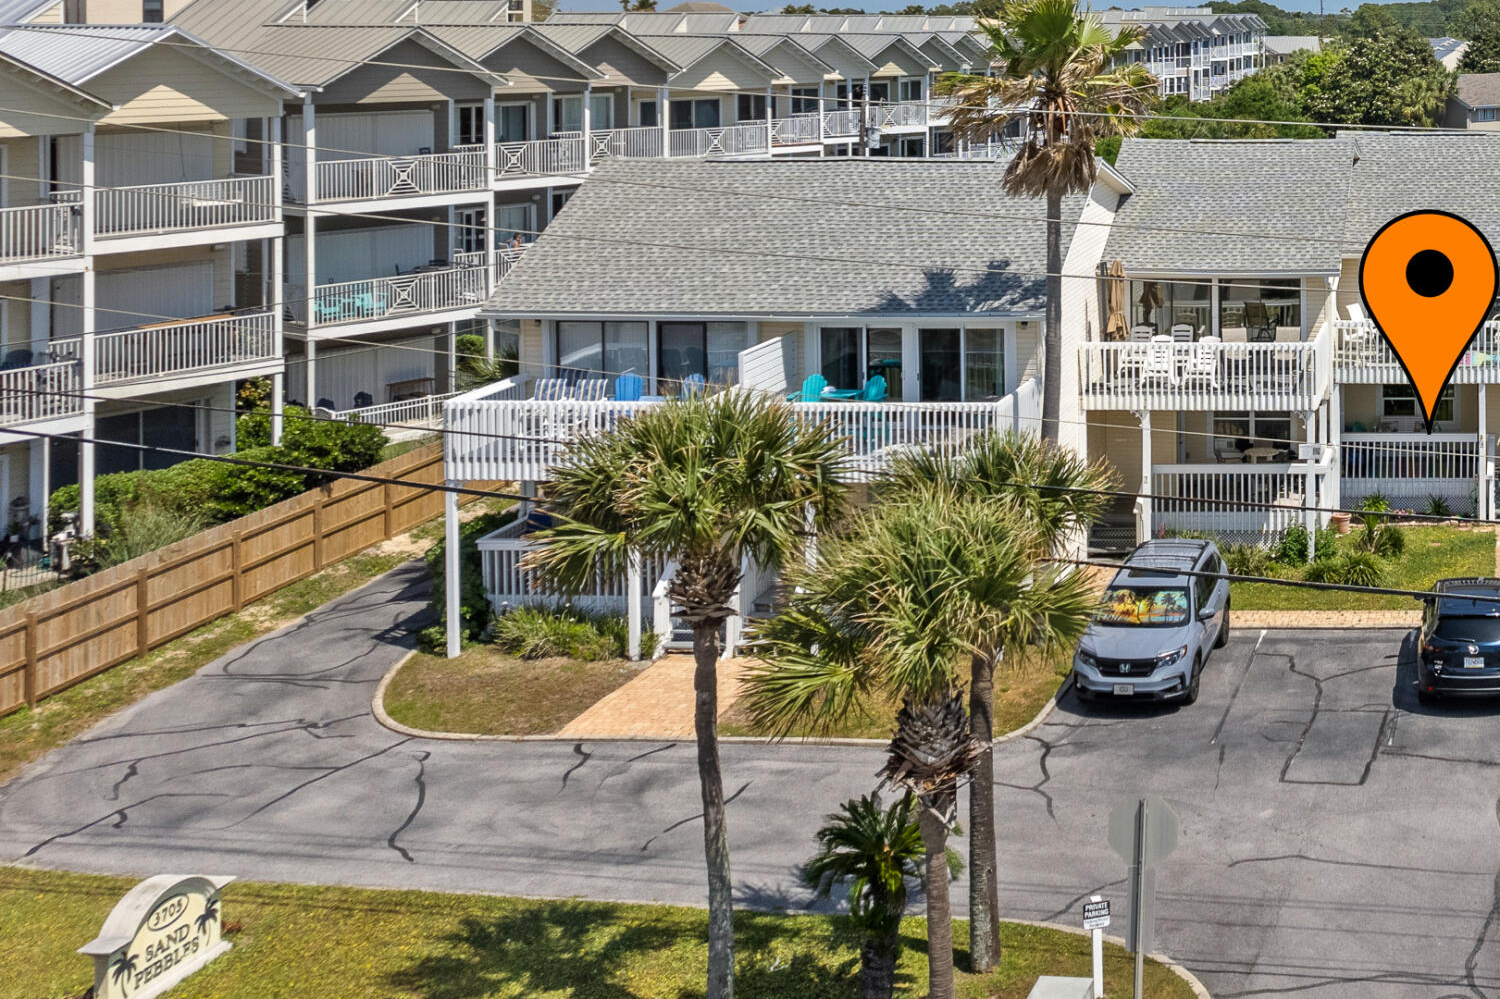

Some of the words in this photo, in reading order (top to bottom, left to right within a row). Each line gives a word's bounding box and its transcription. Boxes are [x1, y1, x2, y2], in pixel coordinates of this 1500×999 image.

[153, 898, 183, 927] 3705
[1084, 909, 1109, 919] PARKING
[1085, 901, 1109, 912] PRIVATE
[145, 923, 190, 962] SAND
[134, 936, 200, 990] PEBBLES
